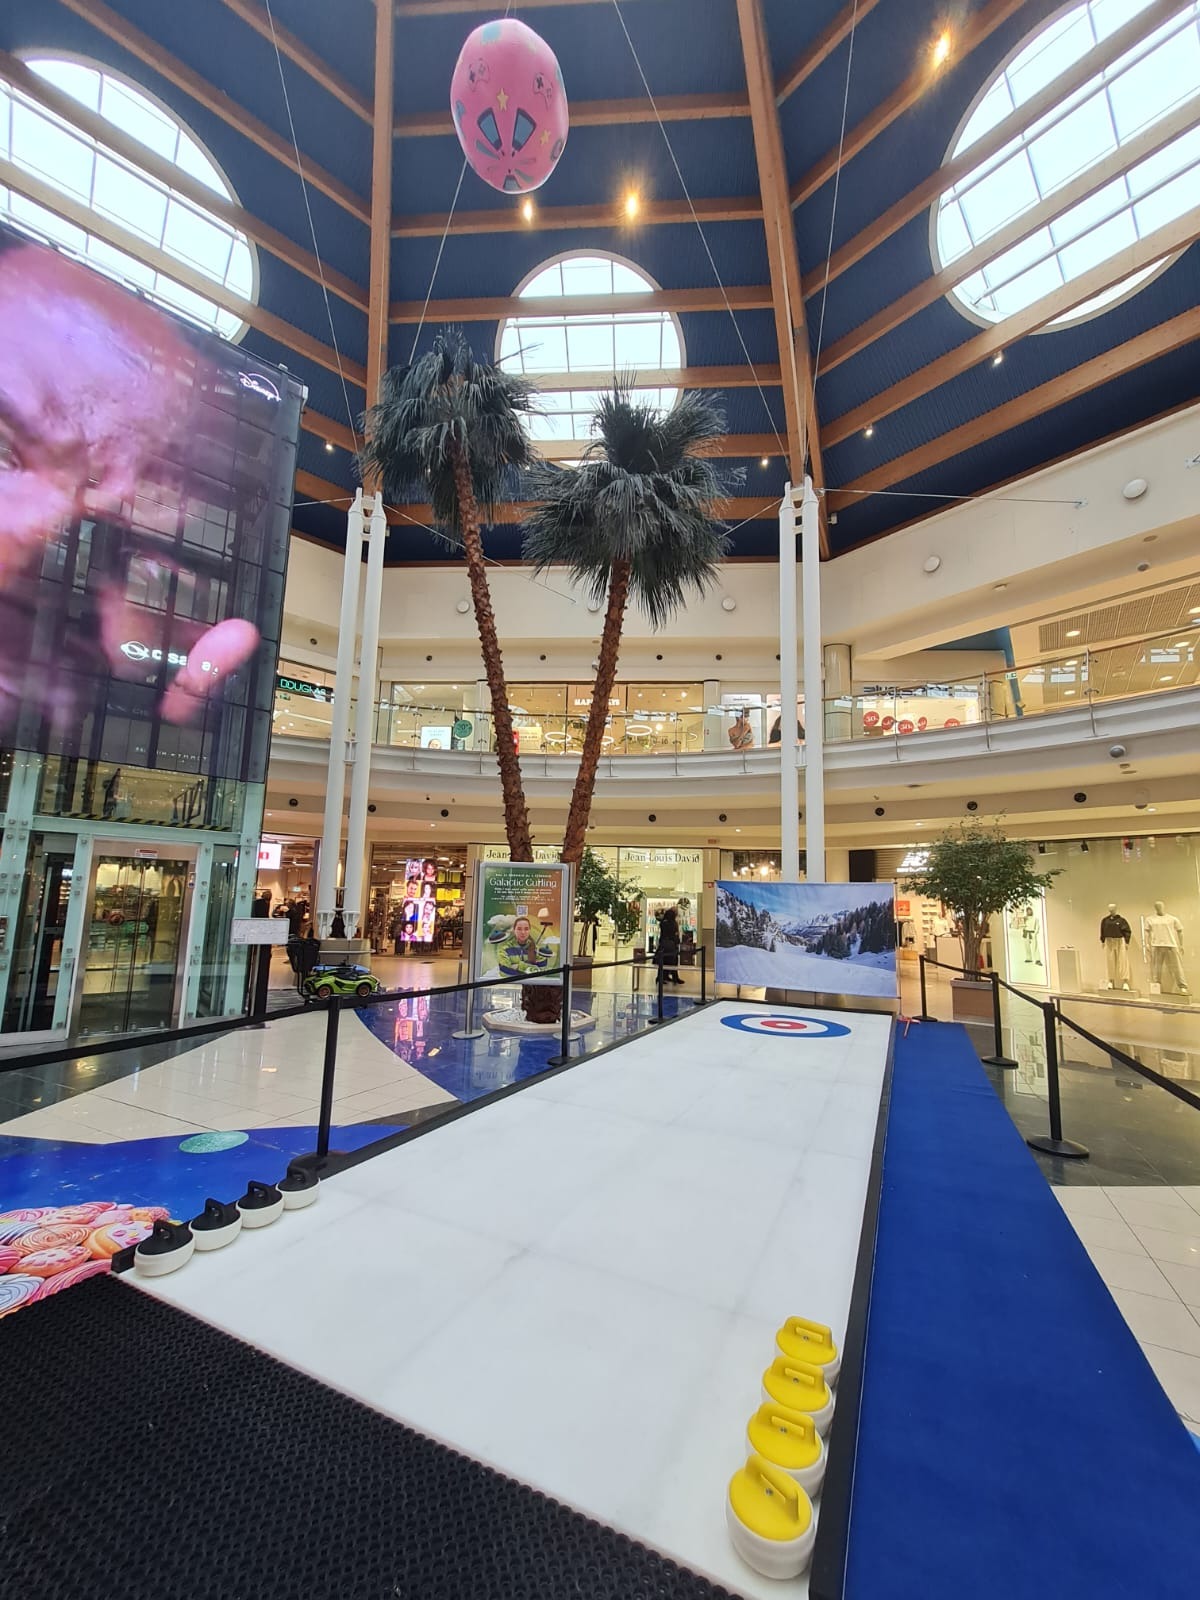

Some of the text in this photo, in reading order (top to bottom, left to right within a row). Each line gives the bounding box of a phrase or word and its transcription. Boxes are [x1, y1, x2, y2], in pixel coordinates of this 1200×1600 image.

[279, 678, 327, 696] DOUGLAS
[648, 852, 673, 864] Louis
[675, 852, 700, 864] David
[489, 877, 557, 888] Galactic Curling
